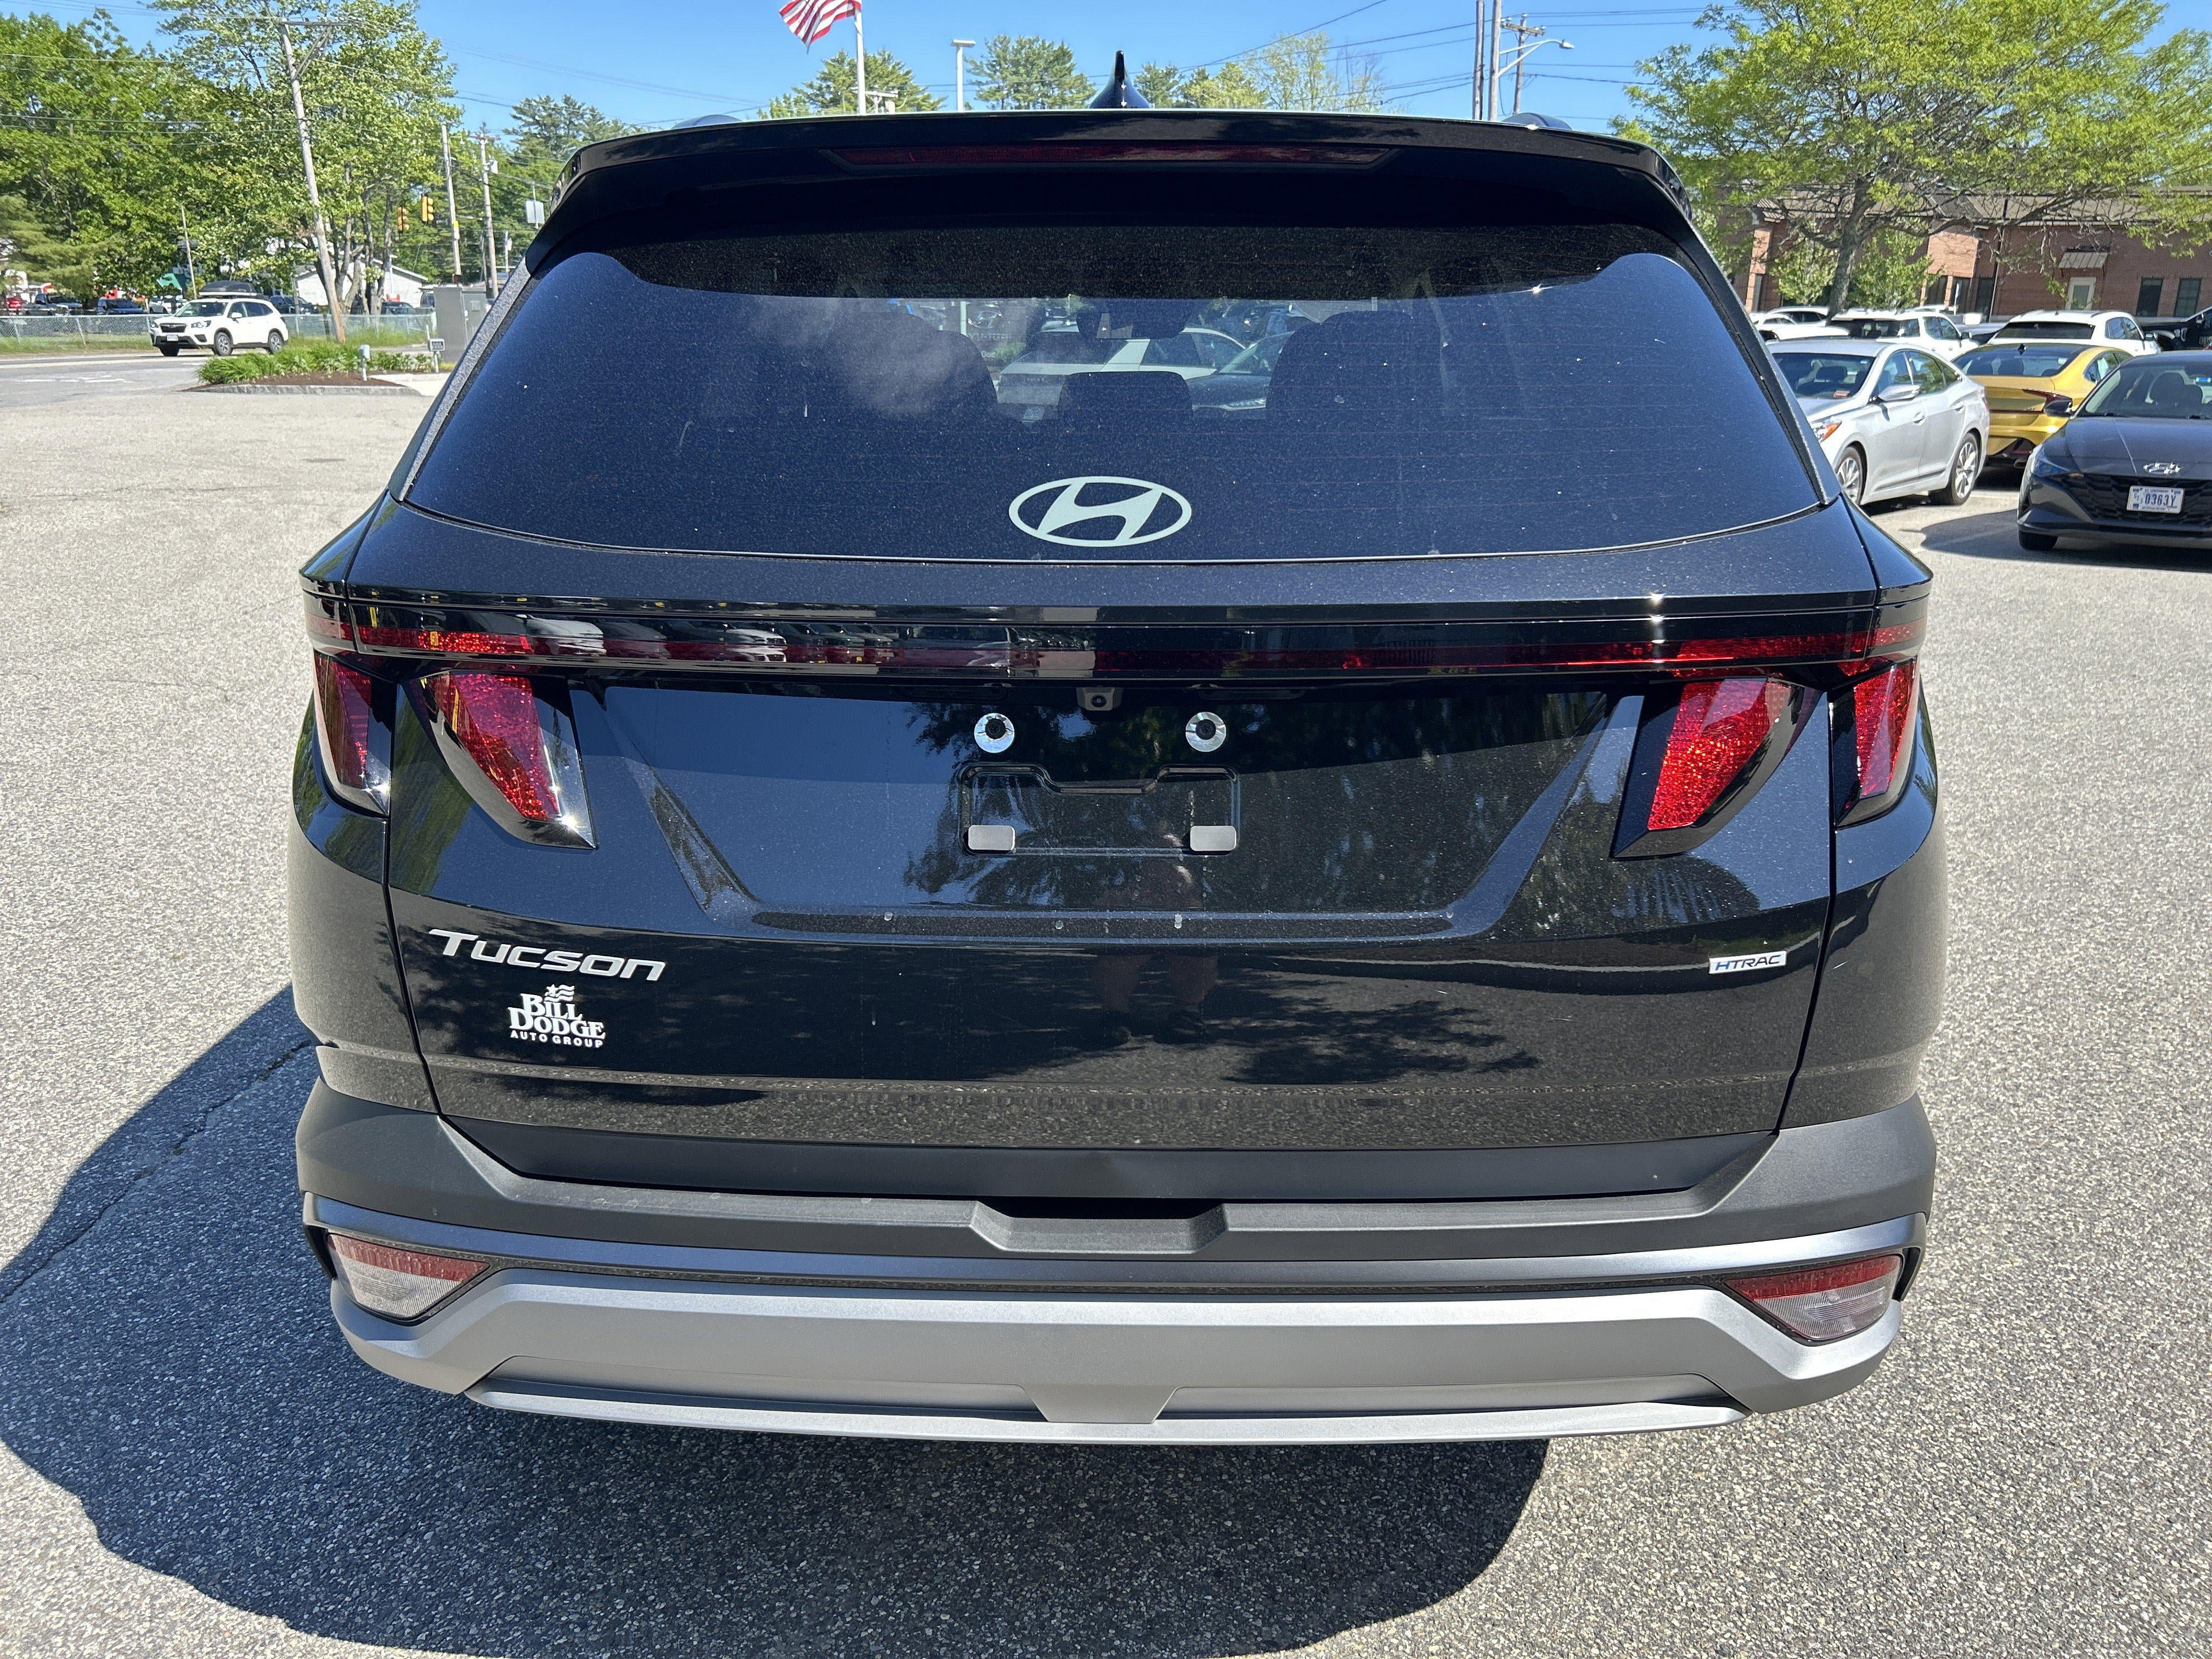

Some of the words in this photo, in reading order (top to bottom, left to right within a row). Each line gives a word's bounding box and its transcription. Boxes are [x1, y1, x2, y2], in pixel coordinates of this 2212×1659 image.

[1715, 954, 1781, 970] HTRAC
[520, 993, 583, 1020] BILL
[507, 1007, 606, 1039] DODGE
[510, 1030, 548, 1042] AUTO
[552, 1035, 603, 1048] GROUP
